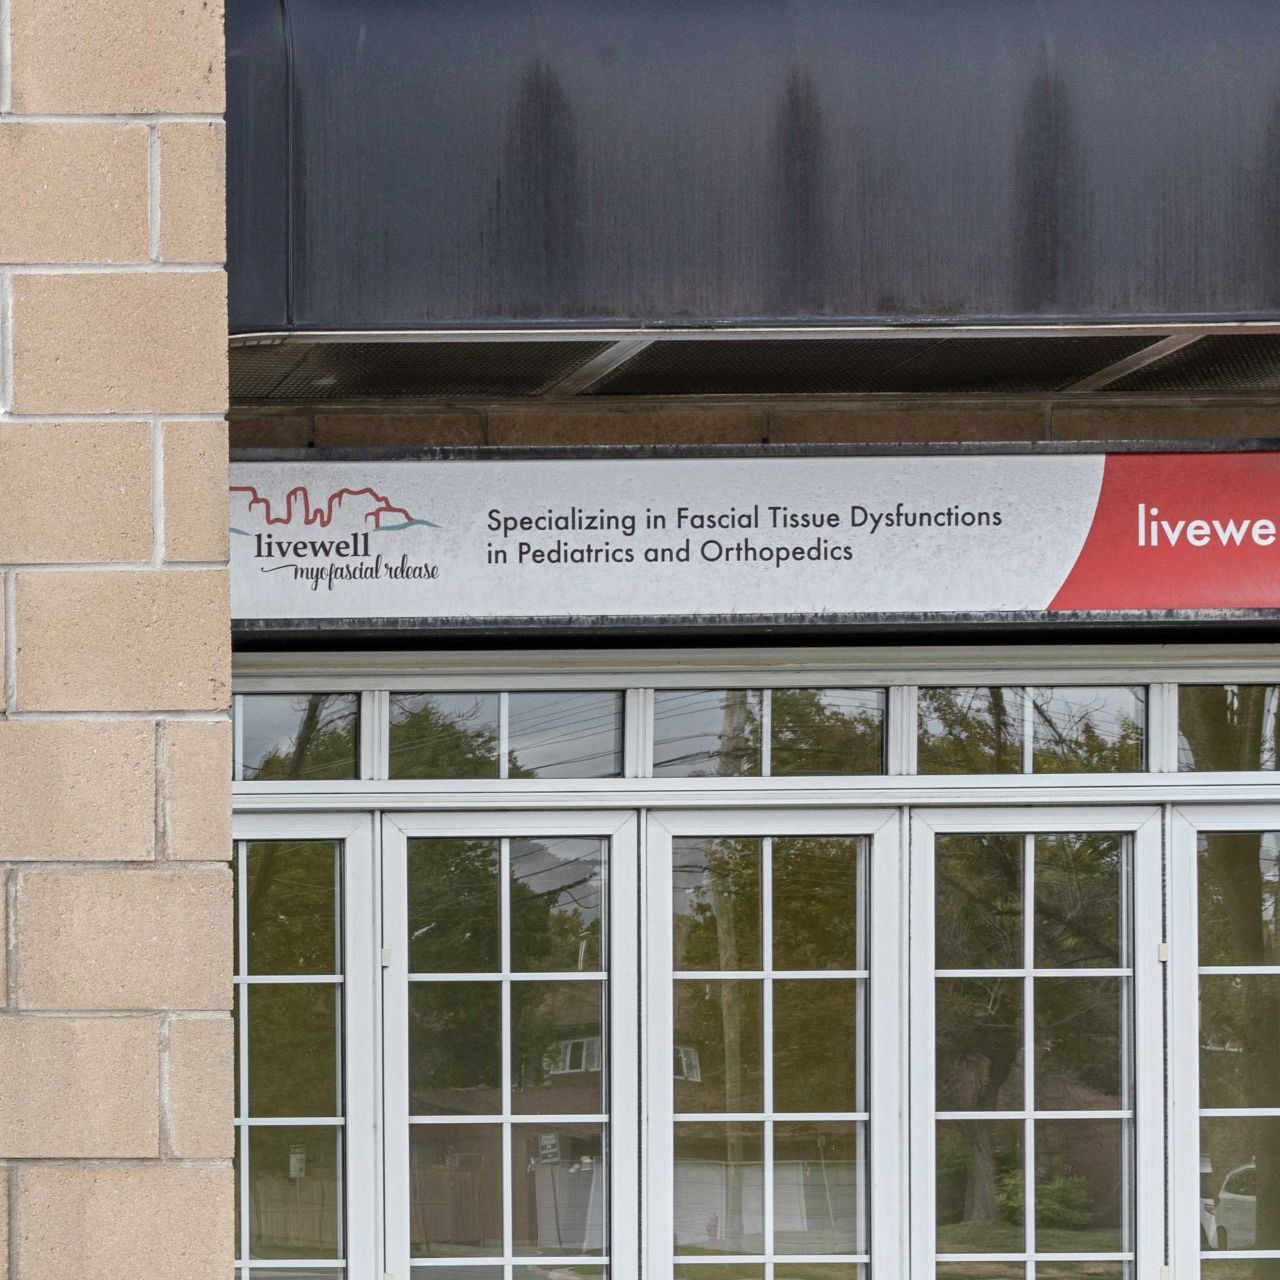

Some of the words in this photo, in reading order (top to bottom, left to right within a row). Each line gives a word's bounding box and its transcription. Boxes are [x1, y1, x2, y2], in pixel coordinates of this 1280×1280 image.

[487, 506, 636, 537] Specializing
[646, 508, 666, 529] in
[677, 507, 759, 529] Fascial
[768, 506, 841, 529] Tissue
[850, 503, 1003, 535] Dysfunctions
[1138, 503, 1277, 547] livewe
[254, 532, 372, 558] livewell
[487, 542, 508, 564] in
[518, 539, 635, 564] Pediatrics
[644, 538, 691, 562] and
[700, 536, 854, 568] Orthopedics
[261, 553, 383, 592] myofascial
[383, 553, 440, 580] release
